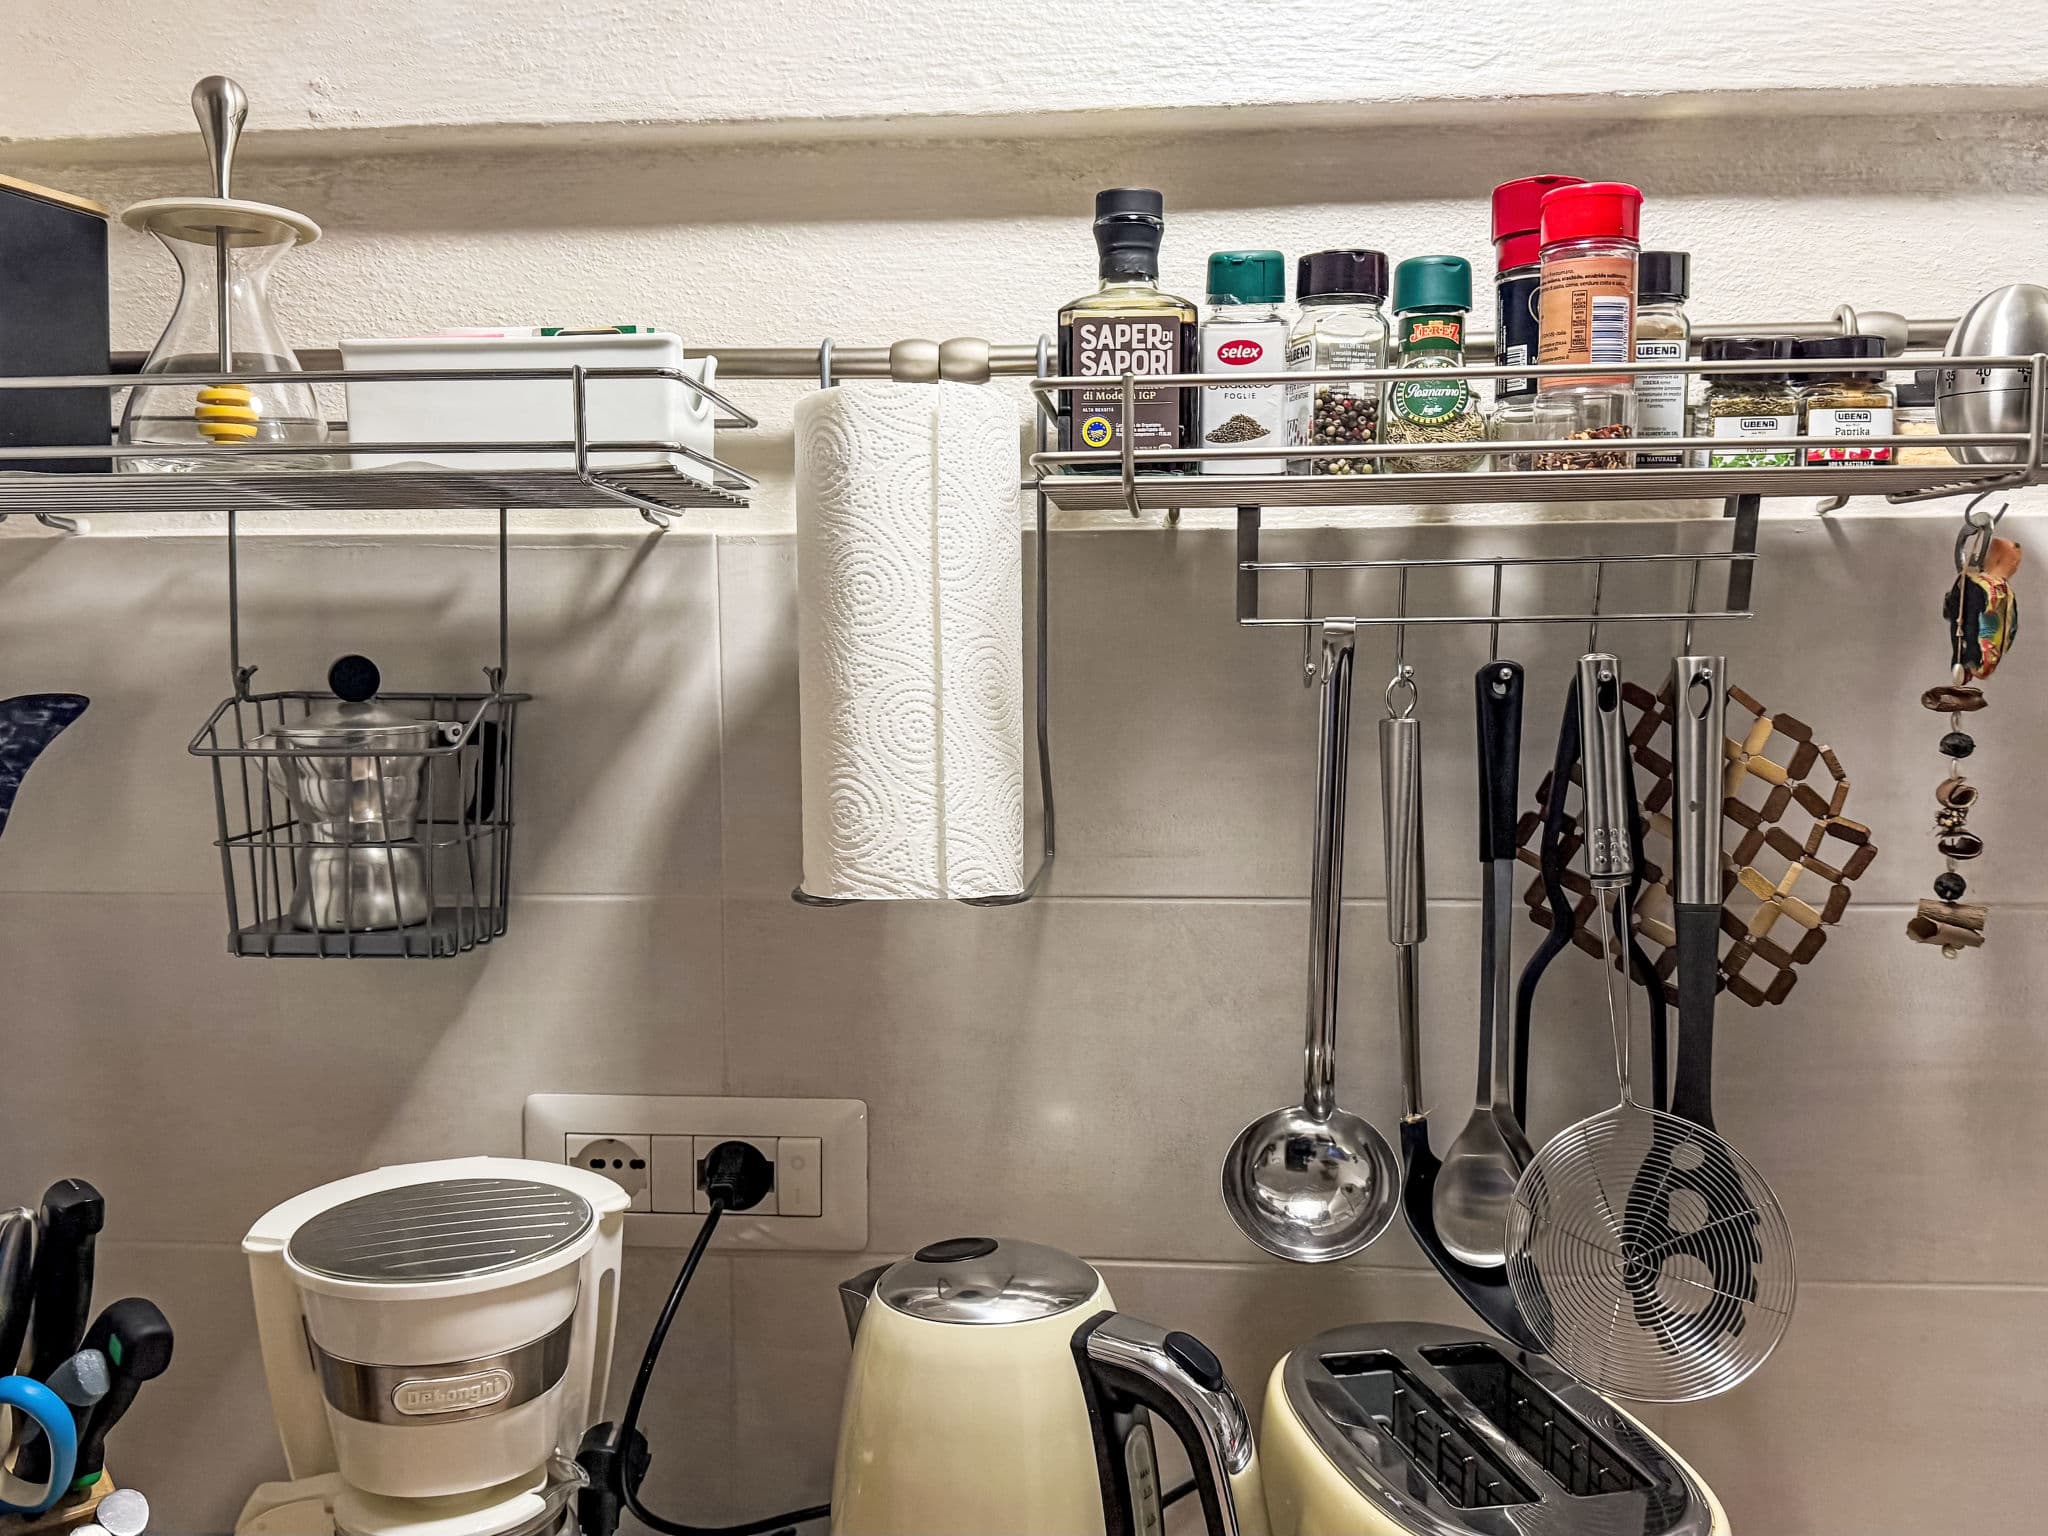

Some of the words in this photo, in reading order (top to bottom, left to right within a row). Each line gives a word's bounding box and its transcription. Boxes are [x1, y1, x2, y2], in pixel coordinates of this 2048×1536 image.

[1080, 323, 1173, 350] SAPER
[1162, 330, 1173, 342] DI
[1410, 323, 1460, 344] JEREZ
[1220, 344, 1260, 358] selex
[1637, 346, 1677, 356] UBENA
[1080, 349, 1173, 376] SAPORI
[1976, 367, 1991, 377] 40
[1083, 391, 1093, 400] di
[1138, 390, 1156, 400] IGP
[1224, 392, 1257, 400] FOGLIE
[1405, 383, 1460, 399] Rosmarino
[1838, 412, 1869, 420] UBENA
[1743, 420, 1775, 428] UBENA
[1835, 427, 1870, 436] Paprika
[1646, 455, 1678, 463] NATURALE
